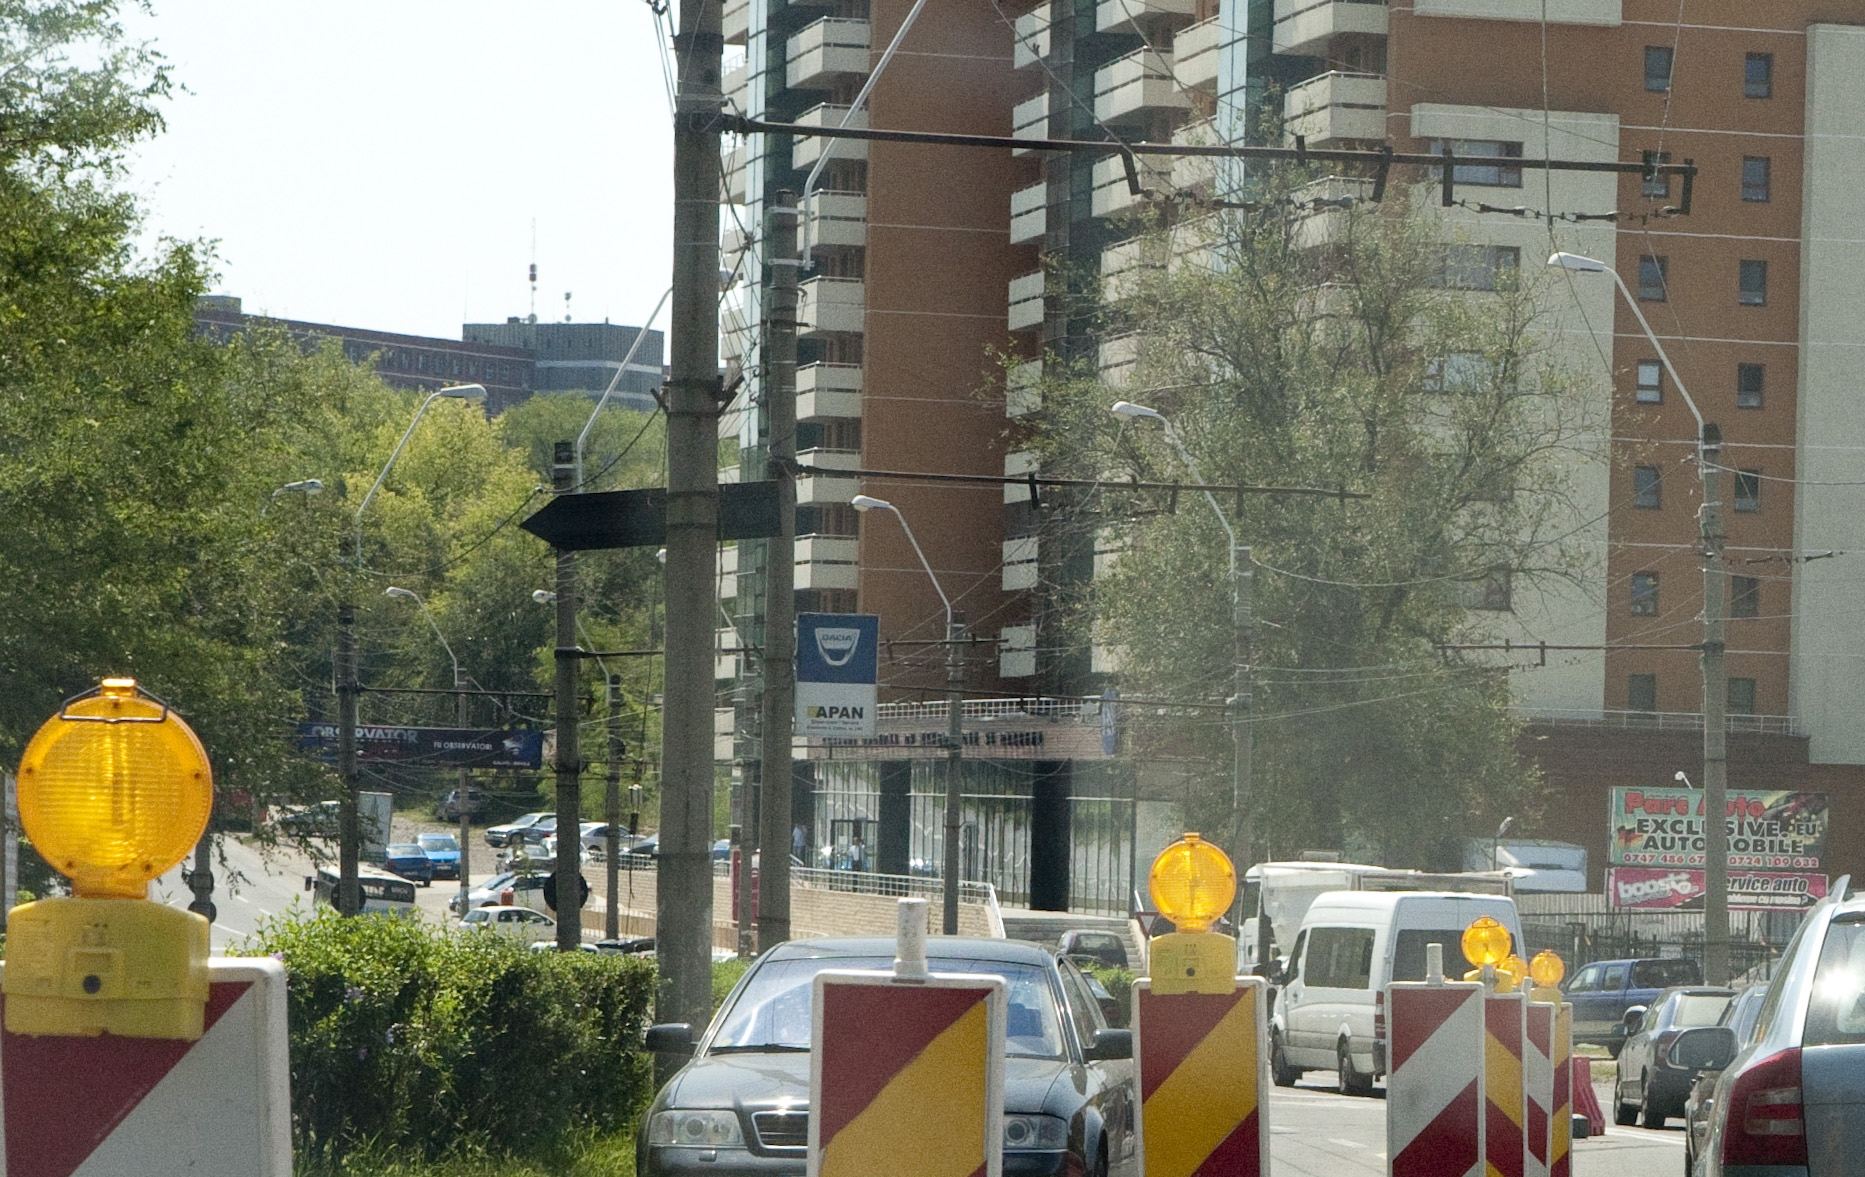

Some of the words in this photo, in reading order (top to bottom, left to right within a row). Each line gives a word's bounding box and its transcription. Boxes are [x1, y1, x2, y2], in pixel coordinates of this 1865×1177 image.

[822, 633, 852, 641] DACIA
[816, 705, 864, 719] APAN
[1624, 791, 1689, 816] Parc
[1636, 818, 1789, 838] EXCLSIVE.
[1796, 823, 1817, 836] EU
[1642, 836, 1803, 854] AUTOOBILE
[1623, 853, 1656, 863] 0747
[1660, 854, 1685, 864] 486
[1728, 856, 1762, 866] 0724
[1767, 857, 1790, 867] 109
[1793, 857, 1819, 868] 632
[1773, 877, 1809, 892] auto
